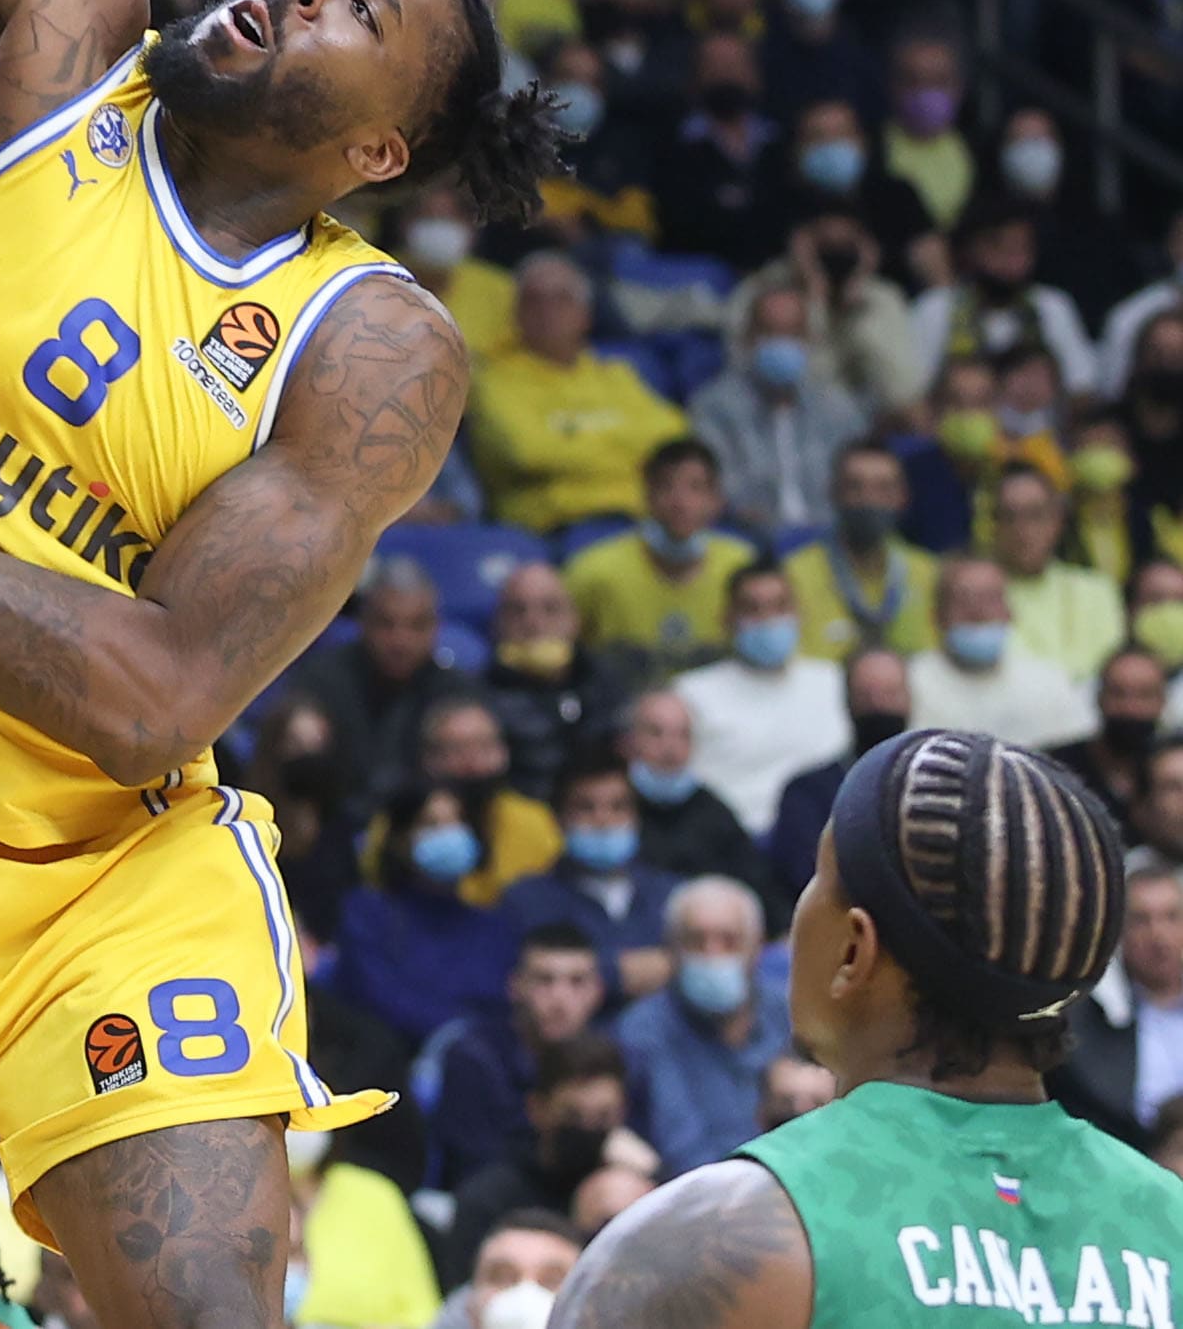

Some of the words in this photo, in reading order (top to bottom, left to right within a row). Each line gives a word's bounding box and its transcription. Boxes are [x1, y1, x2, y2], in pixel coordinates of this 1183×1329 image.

[22, 297, 141, 428] 8
[99, 1060, 143, 1088] TURKISH
[147, 977, 251, 1077] 8
[897, 1224, 1176, 1329] CANAAN
